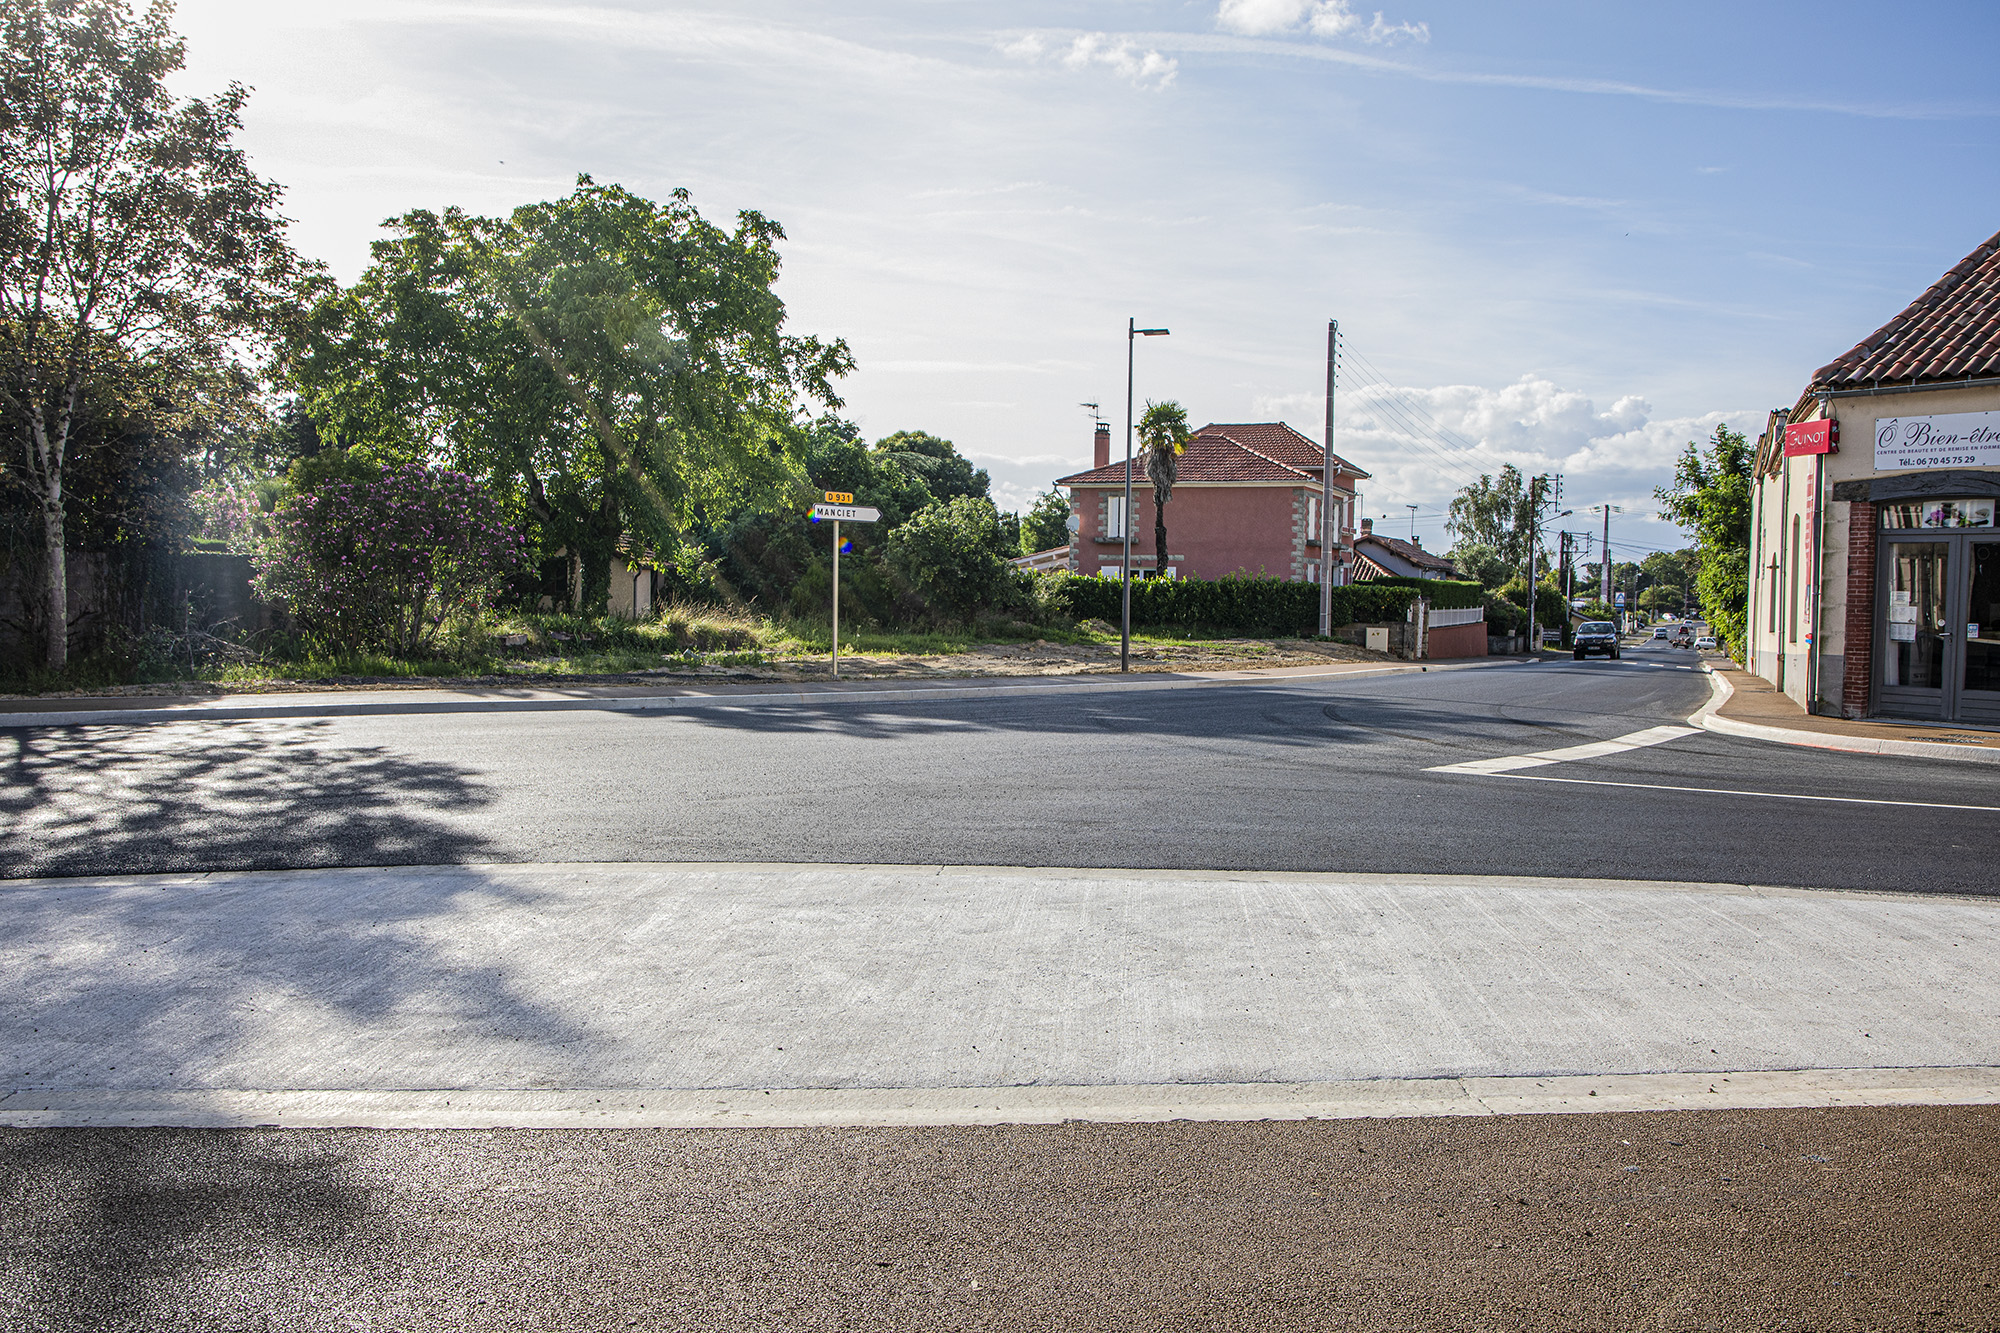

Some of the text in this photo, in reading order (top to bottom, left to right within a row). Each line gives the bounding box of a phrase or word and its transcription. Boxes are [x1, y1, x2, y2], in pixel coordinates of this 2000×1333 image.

[1877, 418, 1898, 448] Ô
[1789, 431, 1825, 446] GUINOT
[1928, 457, 1939, 465] 70
[1952, 456, 1963, 464] 75
[1964, 455, 1975, 463] 29
[828, 493, 851, 502] D 931
[817, 508, 857, 518] MANCIET
